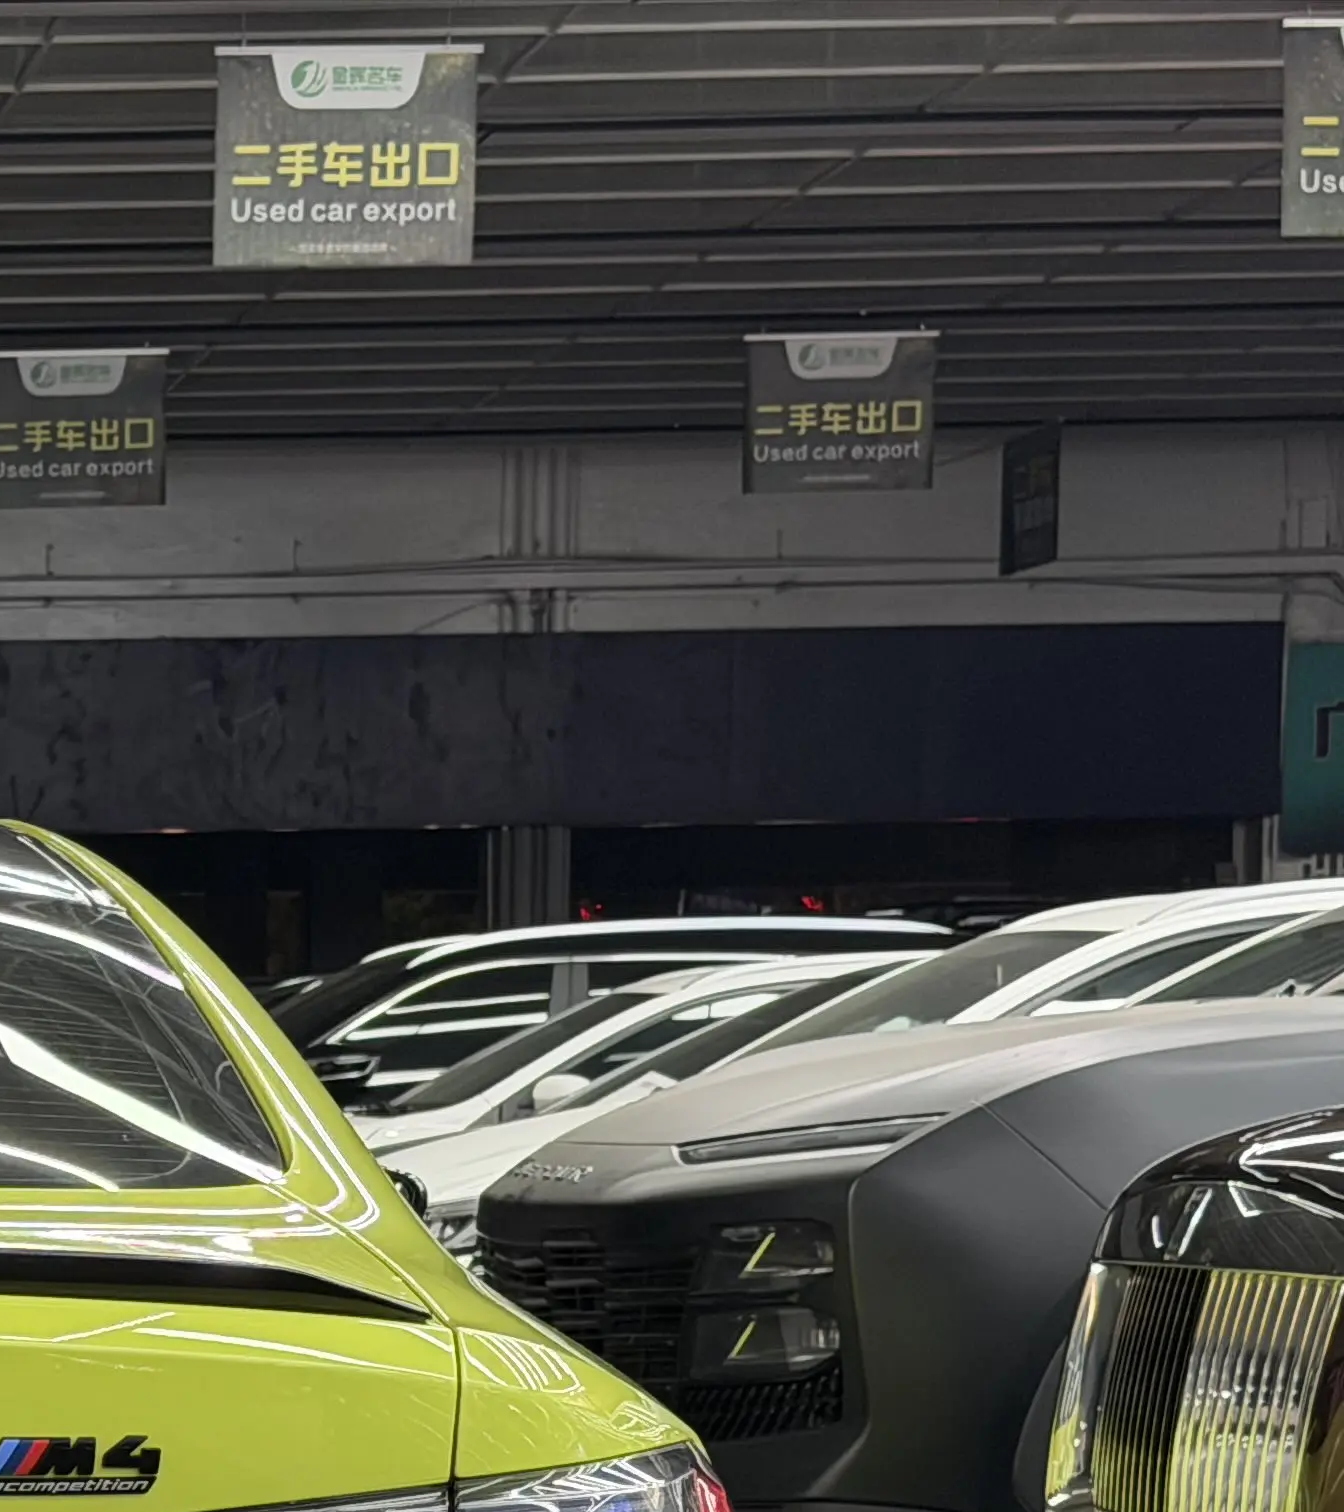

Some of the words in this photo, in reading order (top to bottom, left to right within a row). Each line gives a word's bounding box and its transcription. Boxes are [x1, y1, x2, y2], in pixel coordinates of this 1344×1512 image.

[231, 142, 460, 188] 二手车出口
[230, 197, 305, 224] Used
[310, 203, 358, 223] car
[363, 198, 457, 227] export
[754, 400, 922, 436] 二手车出口
[753, 444, 808, 463] Used
[812, 446, 847, 461] car
[851, 441, 920, 463] export
[48, 462, 81, 478] car
[86, 457, 154, 478] export
[34, 1434, 162, 1477] M4
[2, 1478, 150, 1495] competition
